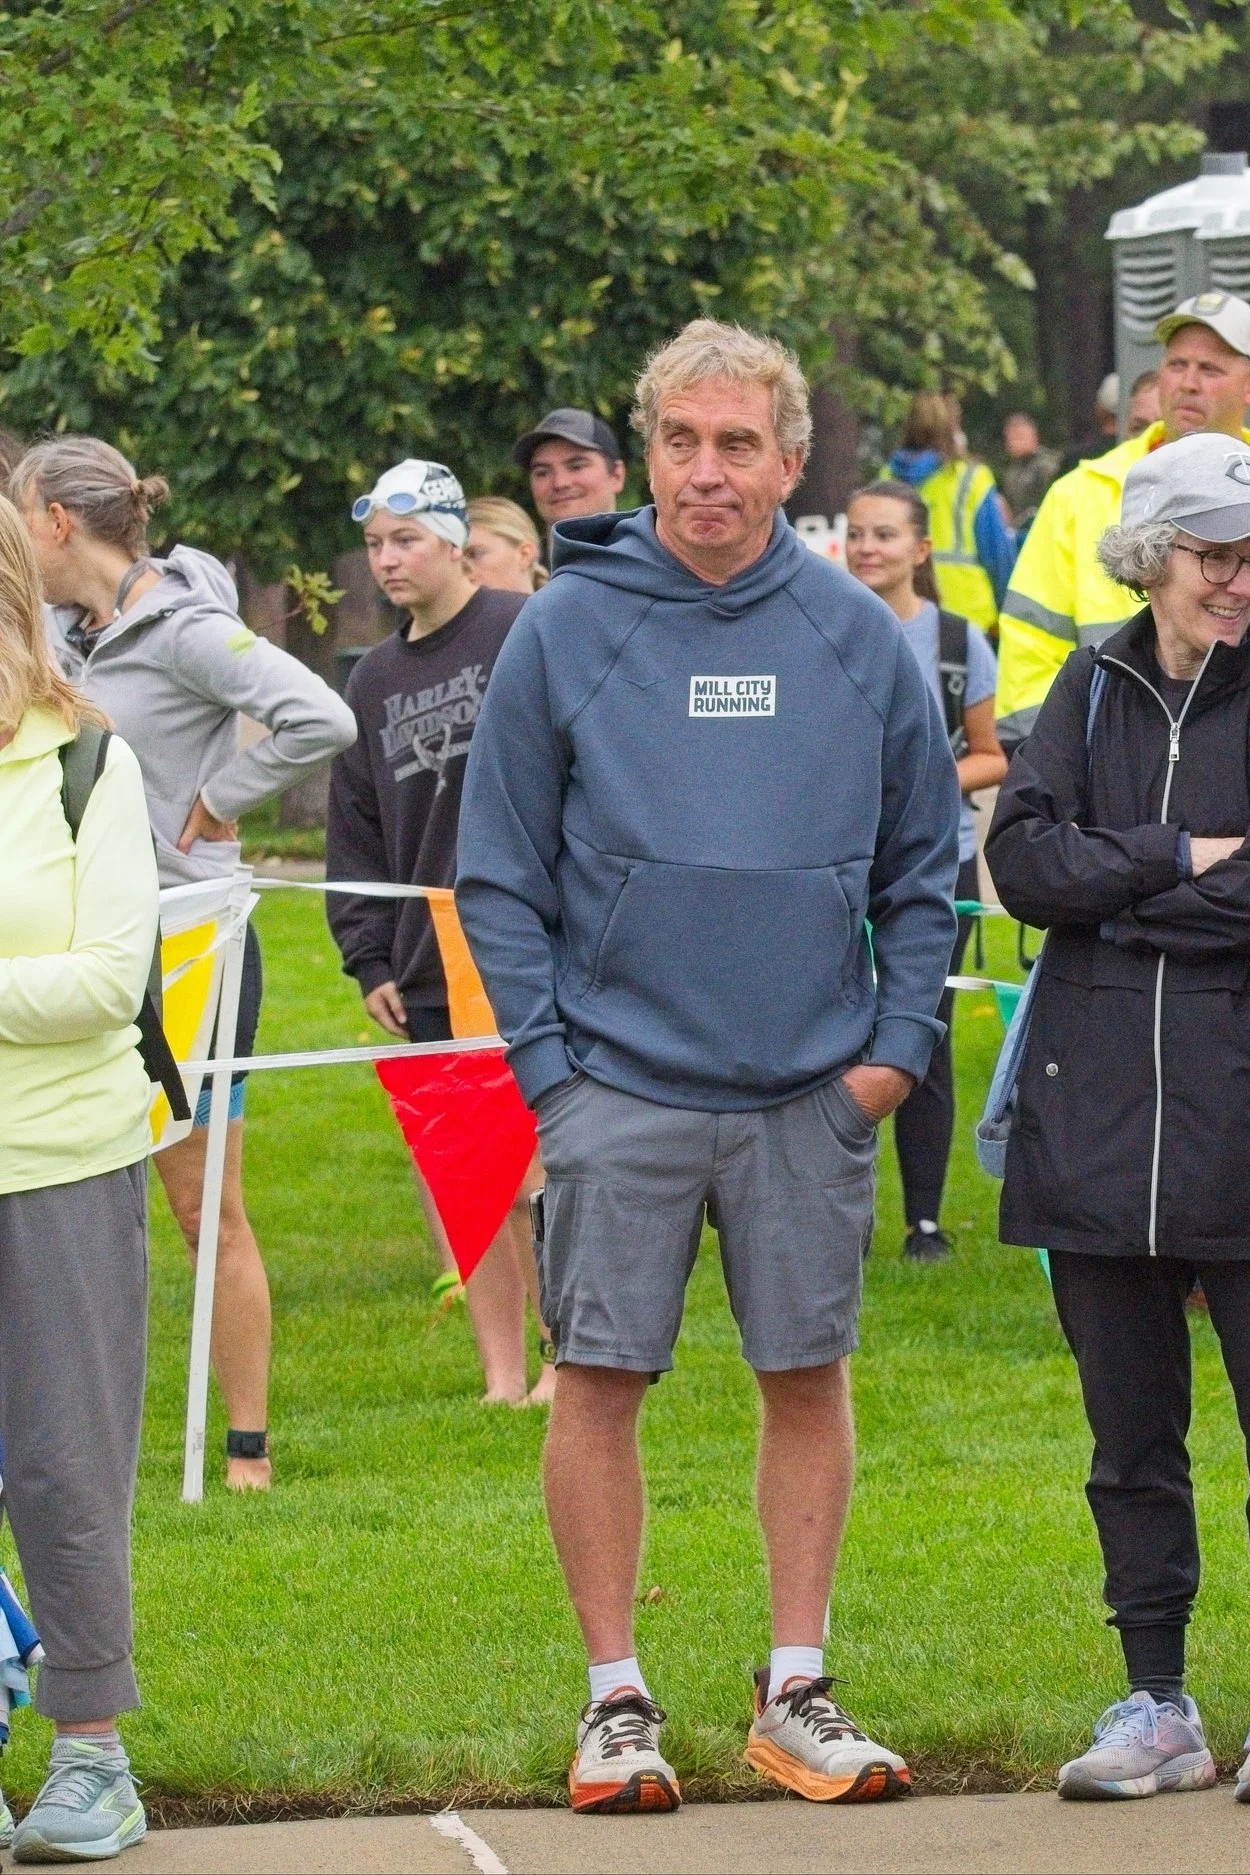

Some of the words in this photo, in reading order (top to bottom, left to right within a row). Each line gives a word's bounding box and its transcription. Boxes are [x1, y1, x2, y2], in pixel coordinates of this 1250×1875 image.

[695, 680, 733, 696] MILL
[736, 680, 771, 696] CITY
[694, 697, 771, 713] RUNNING
